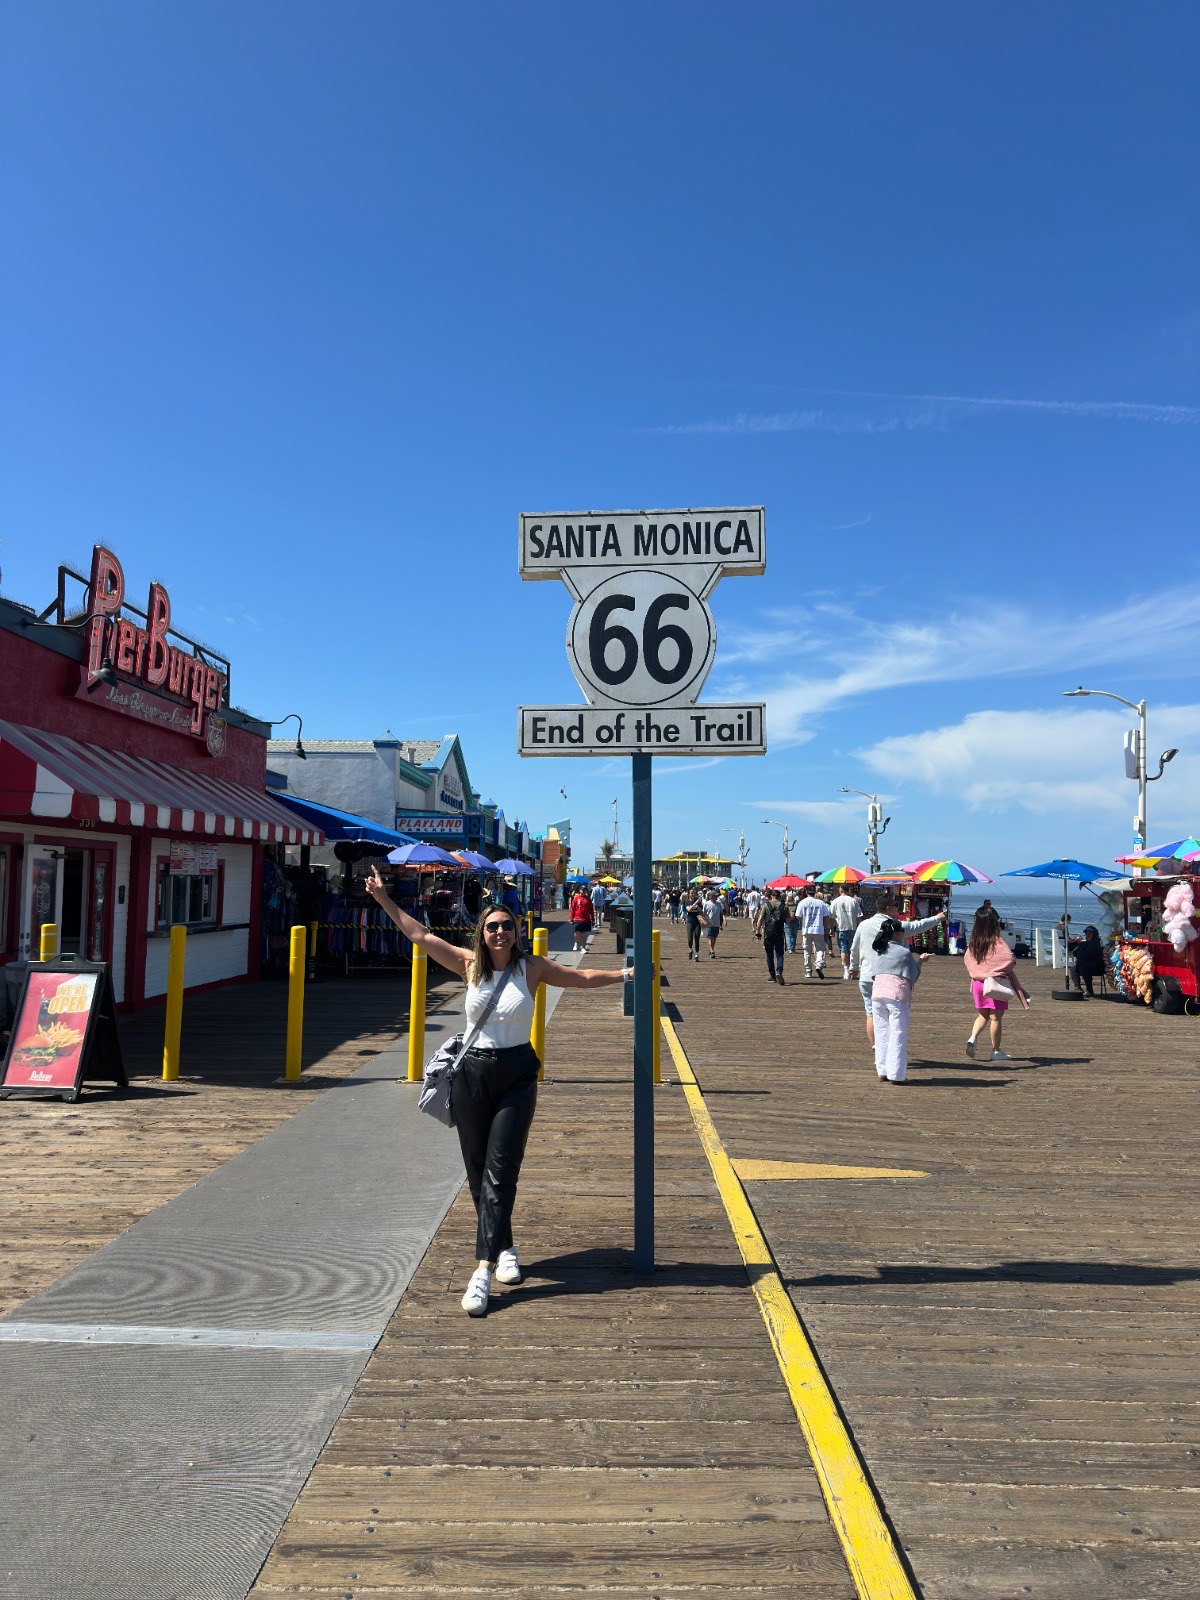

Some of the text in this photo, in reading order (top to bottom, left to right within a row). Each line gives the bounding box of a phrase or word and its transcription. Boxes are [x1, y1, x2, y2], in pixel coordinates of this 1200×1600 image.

[529, 519, 754, 559] SANTA MONICA
[588, 593, 693, 685] 66
[532, 711, 752, 744] End of the Trail
[398, 819, 462, 828] PLAYLAND
[48, 996, 87, 1014] OPEN
